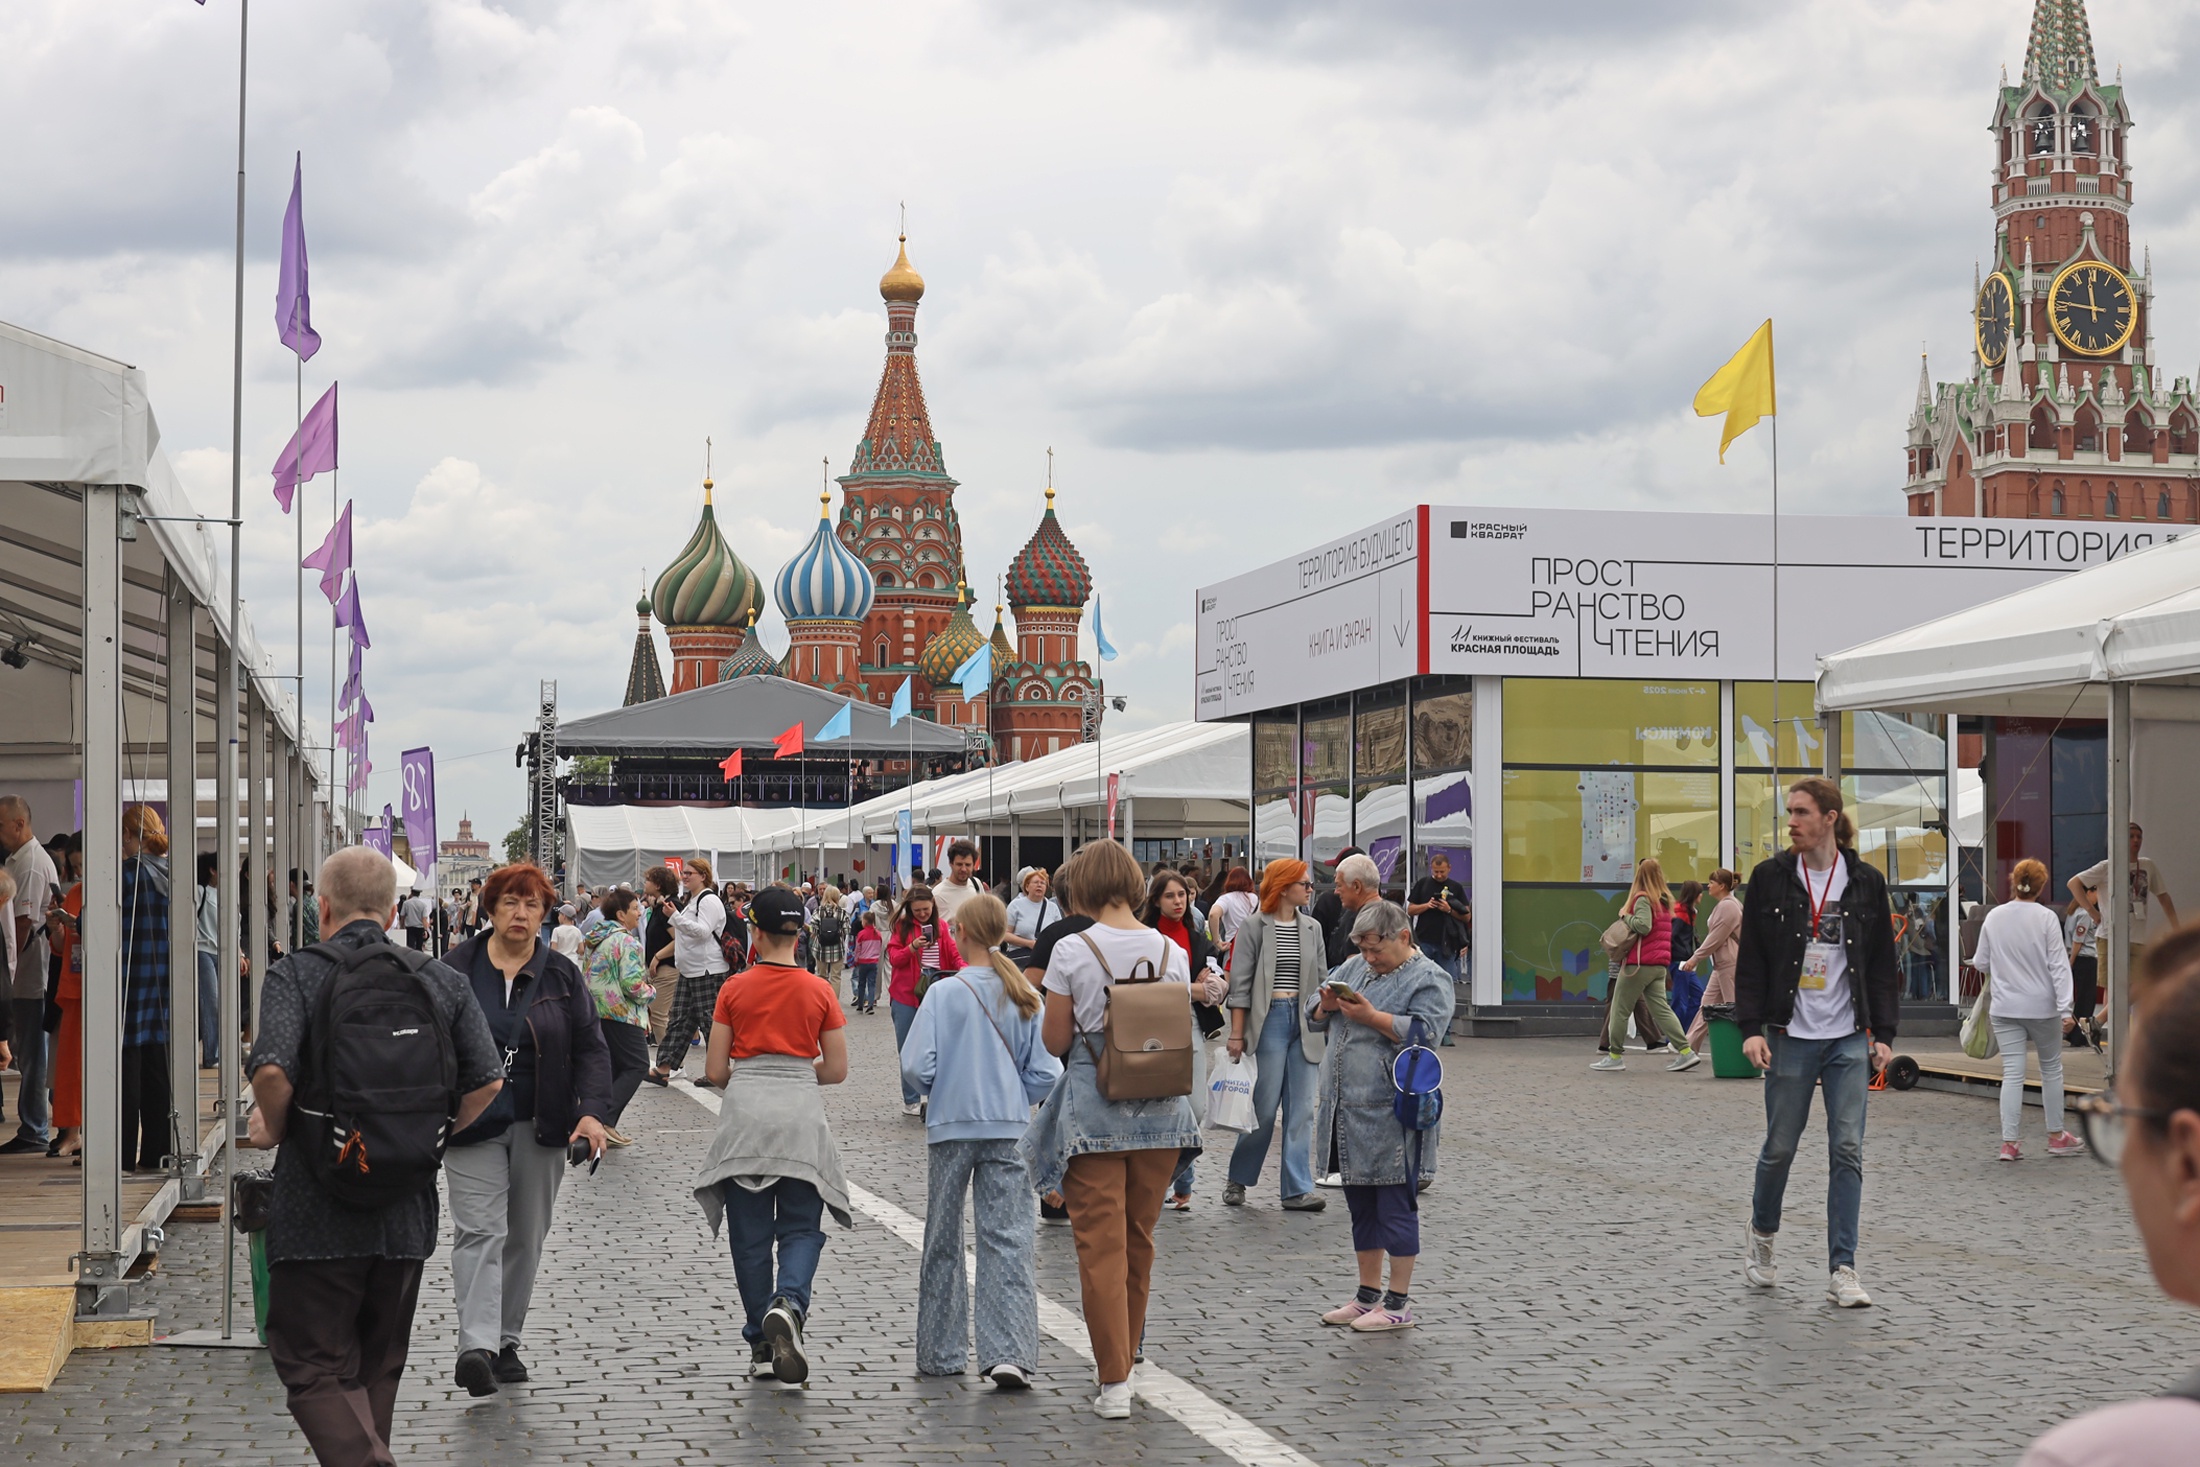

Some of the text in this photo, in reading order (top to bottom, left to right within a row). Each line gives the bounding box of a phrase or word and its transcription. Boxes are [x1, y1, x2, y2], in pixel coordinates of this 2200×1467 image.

[1471, 523, 1528, 532] КРАСНЫЙ
[1471, 531, 1525, 540] КВАДРАТ
[1298, 518, 1414, 590] ТЕРРИТОРИЯ БУДУЩЕГО
[1532, 557, 1638, 587] ПРОСТ
[1532, 590, 1686, 621] РАНСТВО
[1216, 617, 1238, 644] ПРОСТ
[1309, 617, 1371, 658] КНИГА И ЭКРАН
[1472, 633, 1513, 643] КНИЖНЫЙ
[1513, 635, 1560, 644] ФЕСТИВАЛЬ
[1594, 628, 1719, 658] ЧТЕНИЯ
[1450, 643, 1560, 657] КРАСНАЯ ПЛОЩАДЬ
[1225, 1085, 1250, 1094] ГОРОД
